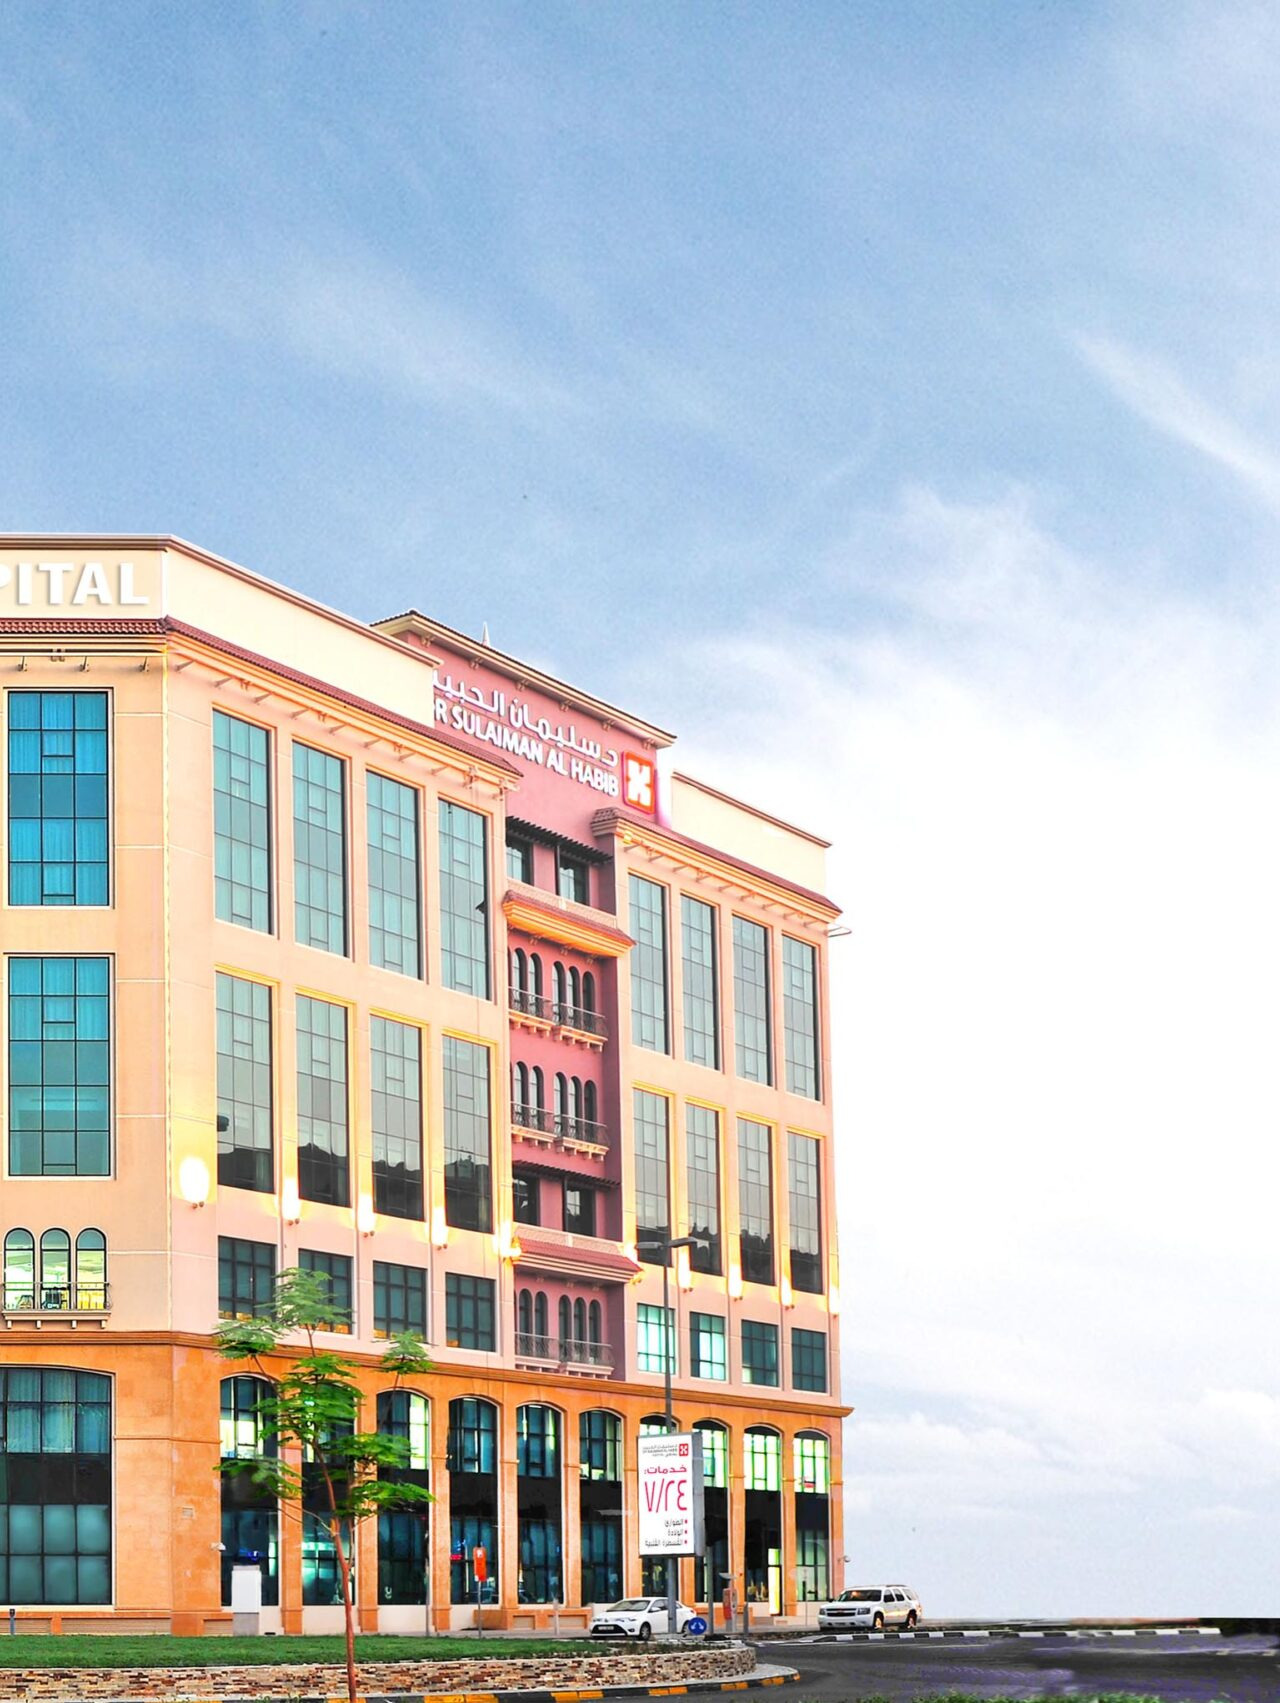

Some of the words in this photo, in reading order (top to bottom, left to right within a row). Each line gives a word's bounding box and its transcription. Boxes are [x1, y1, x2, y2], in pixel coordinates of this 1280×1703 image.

[433, 697, 449, 724] R
[450, 705, 544, 765] SULAIMAN
[545, 747, 569, 776] AL
[570, 757, 620, 798] HABIB
